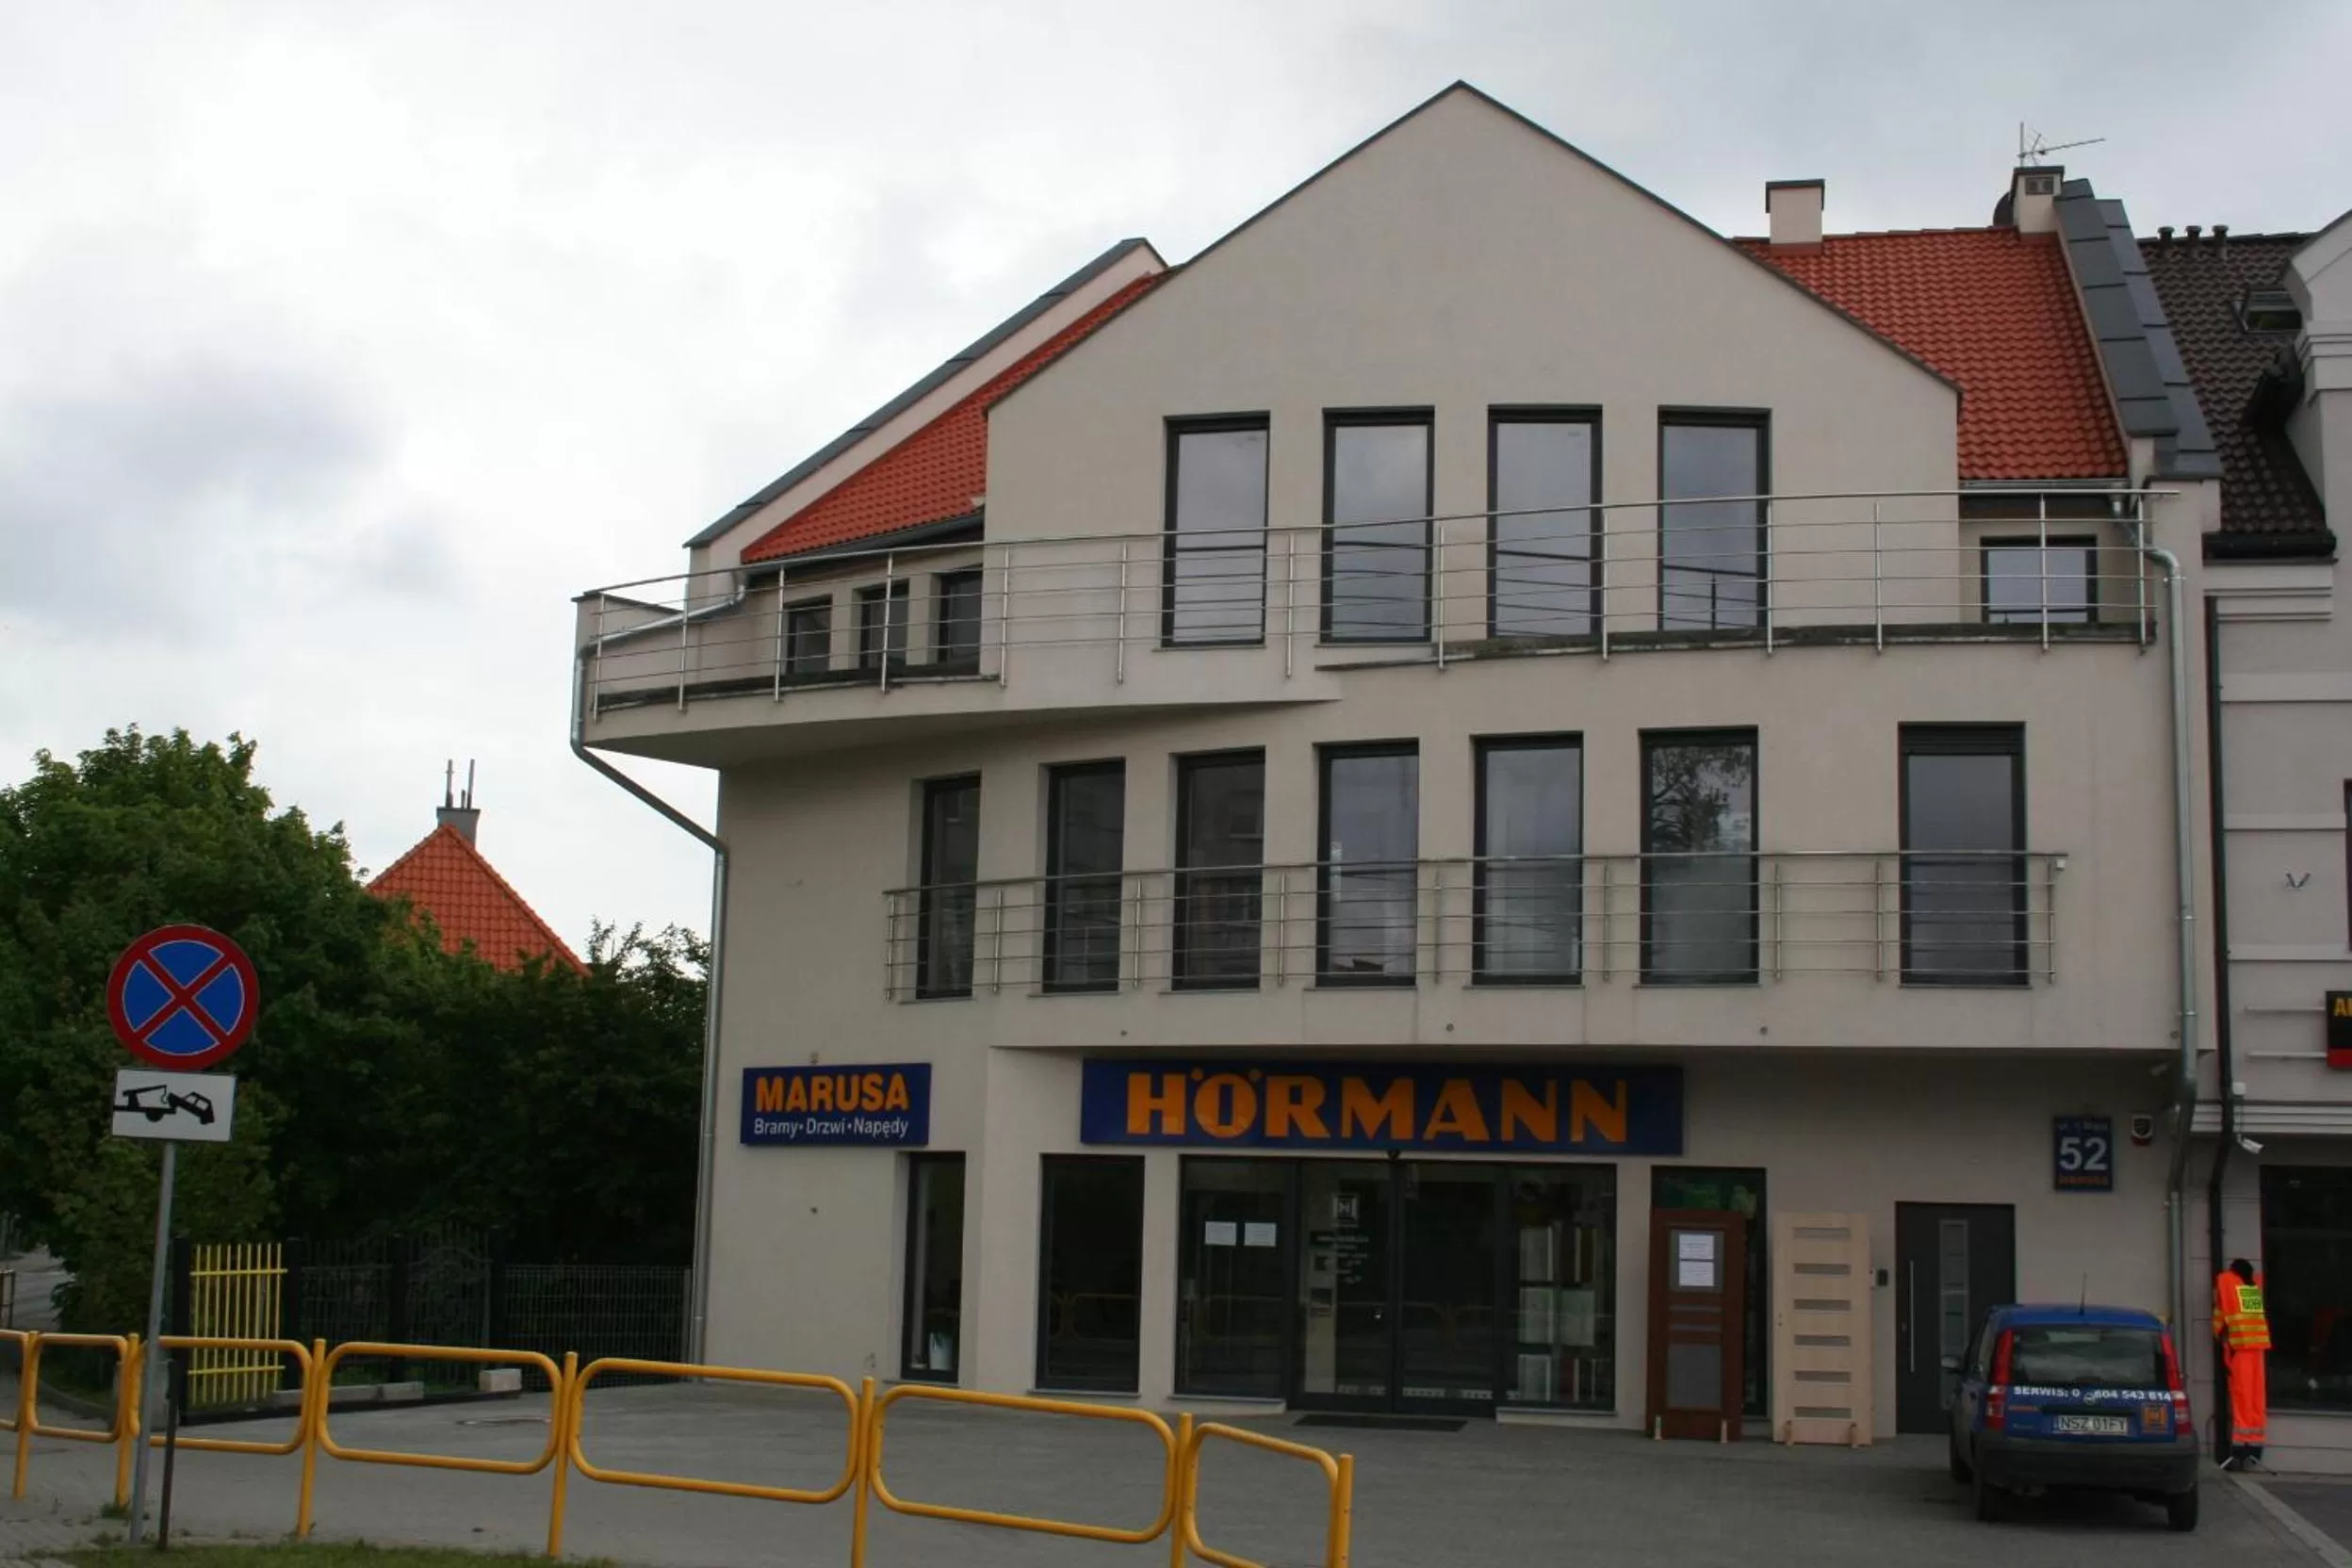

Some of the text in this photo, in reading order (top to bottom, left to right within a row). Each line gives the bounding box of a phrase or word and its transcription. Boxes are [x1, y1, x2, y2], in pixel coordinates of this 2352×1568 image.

[756, 1071, 909, 1113] MARUSA
[1126, 1067, 1628, 1144] HÖRMANN
[755, 1116, 909, 1138] Bramy Drzwi Napędy
[2059, 1136, 2108, 1170] 52
